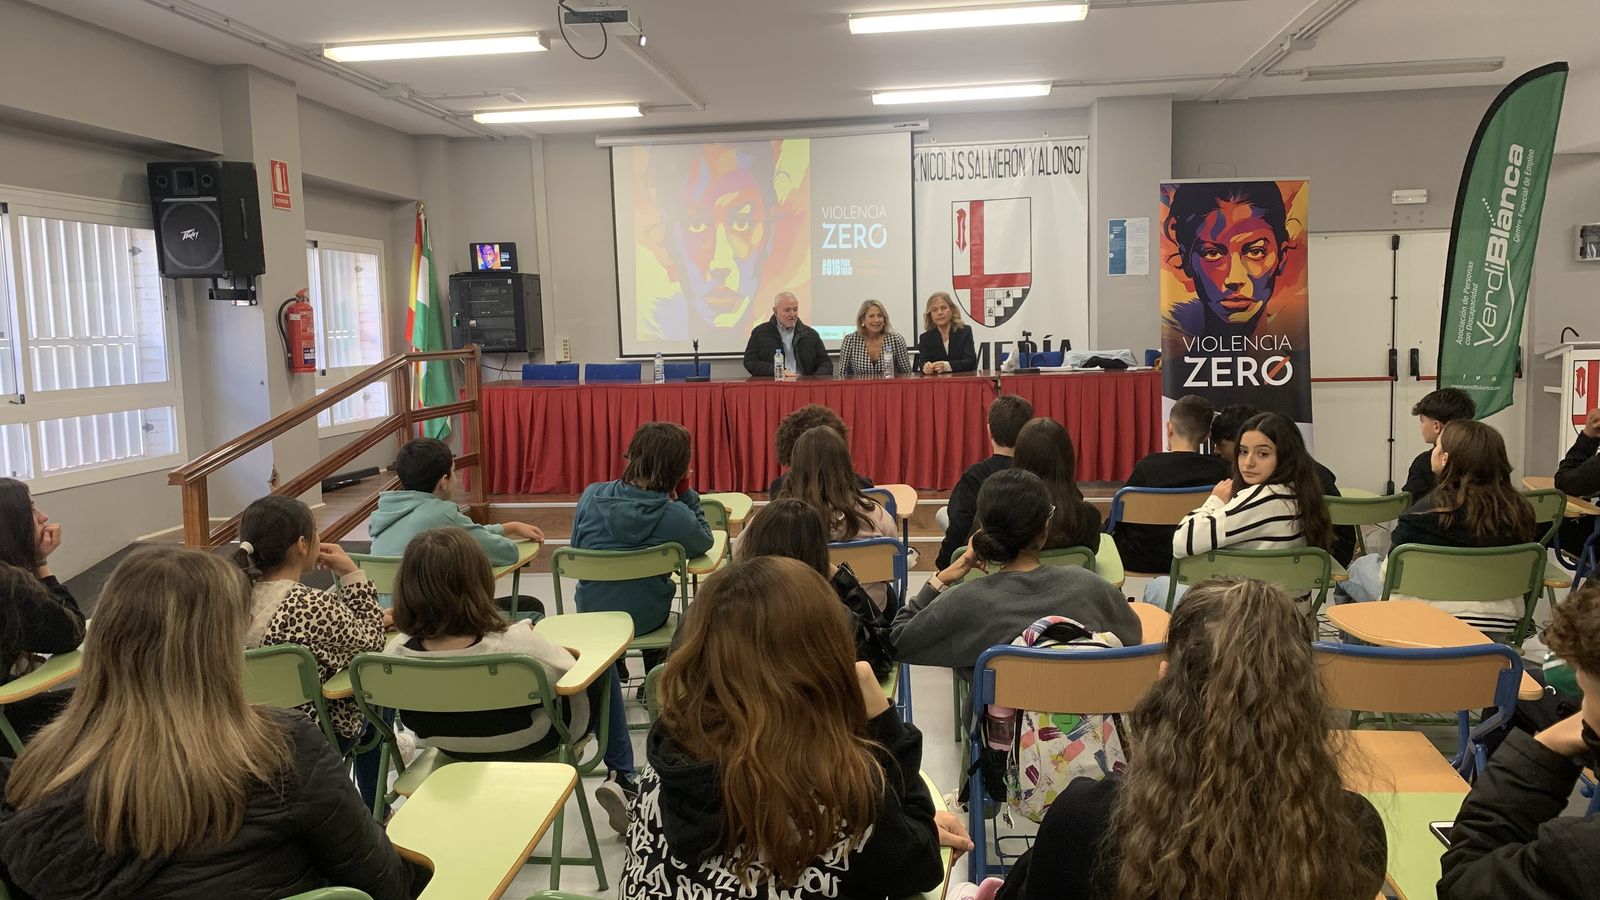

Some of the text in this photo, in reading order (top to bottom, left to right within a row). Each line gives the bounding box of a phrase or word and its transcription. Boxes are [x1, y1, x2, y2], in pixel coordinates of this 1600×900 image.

[968, 145, 1026, 180] SALMERÓN
[821, 205, 887, 219] VIOLENCIA
[1513, 148, 1535, 243] Centro Especial de Empleo
[822, 223, 888, 249] ZERO
[1456, 261, 1474, 345] Asociación de Personas
[1466, 282, 1479, 331] Discapacidad
[1182, 334, 1293, 352] VIOLENCIA
[1183, 355, 1293, 388] ZERO
